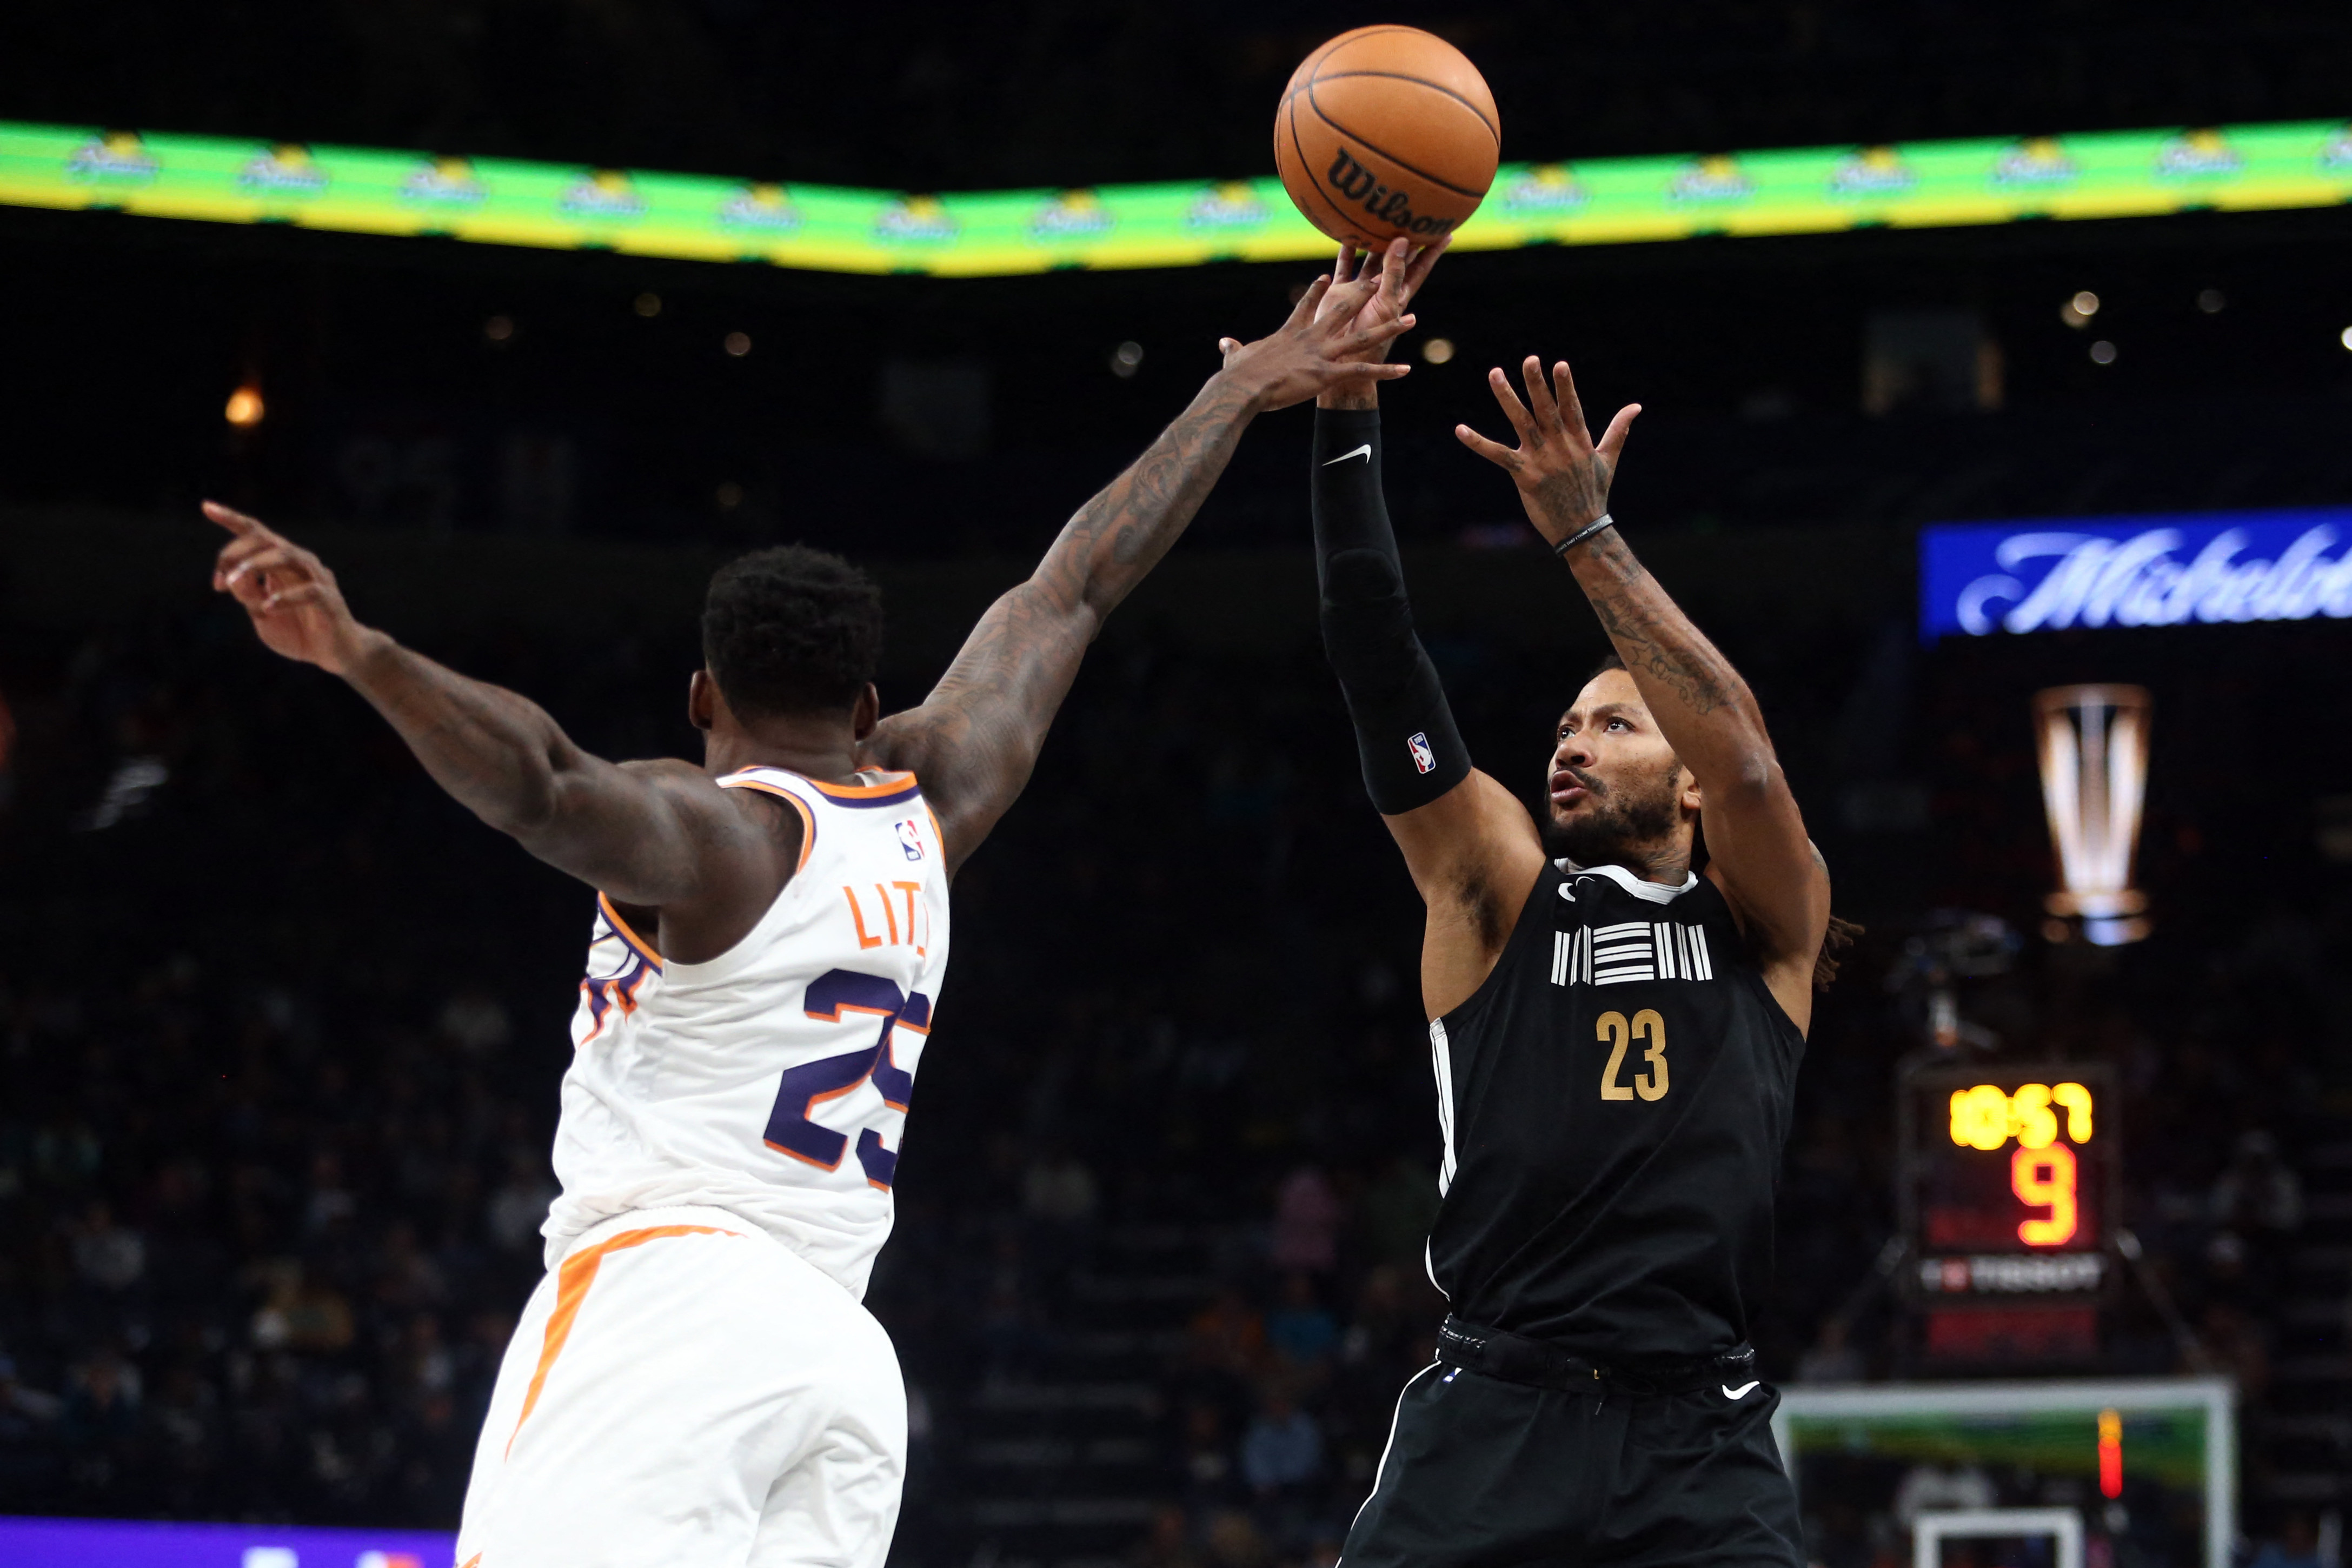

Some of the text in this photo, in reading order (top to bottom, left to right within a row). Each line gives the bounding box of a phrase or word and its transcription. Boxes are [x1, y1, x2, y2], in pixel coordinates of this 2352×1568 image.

[1328, 145, 1455, 235] Wilson
[843, 881, 928, 958] LIT
[763, 968, 931, 1194] 25
[1596, 1008, 1670, 1101] 23
[1950, 1082, 2092, 1151] 10:57
[2011, 1141, 2077, 1246] 9
